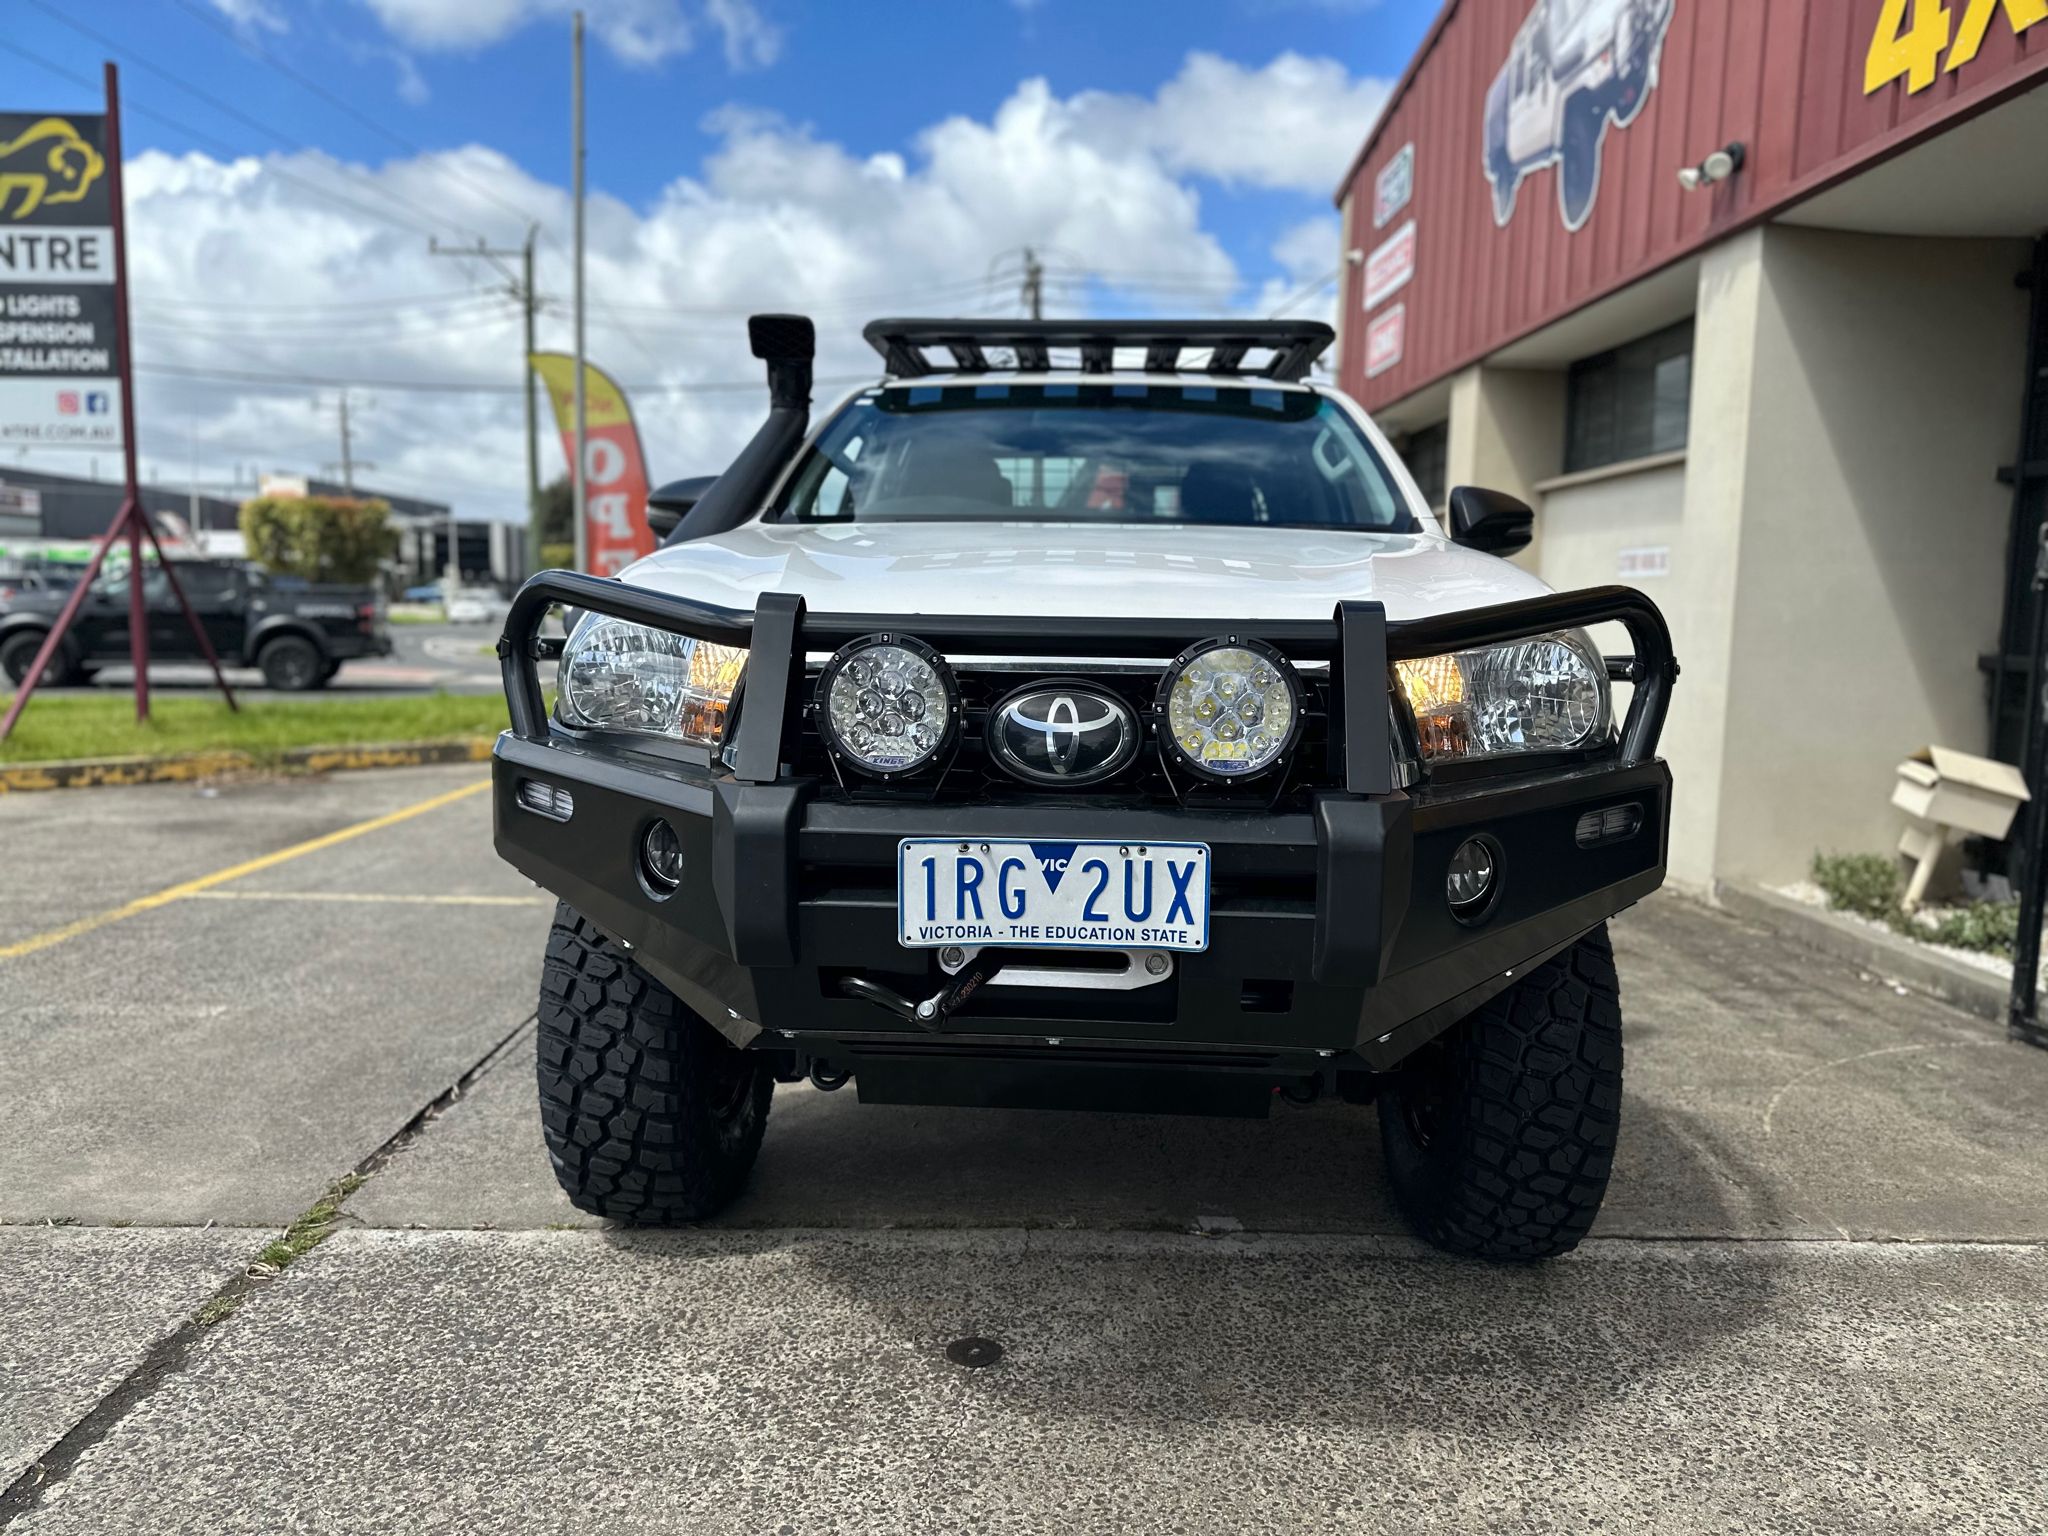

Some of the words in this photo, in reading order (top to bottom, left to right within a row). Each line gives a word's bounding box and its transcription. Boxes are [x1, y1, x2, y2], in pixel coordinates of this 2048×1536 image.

[7, 296, 80, 317] LIGHTS
[0, 349, 109, 371] TALLATION
[872, 757, 905, 765] KINGS
[1038, 857, 1069, 873] VIC
[921, 856, 1026, 921] 1RG
[1081, 858, 1197, 926] 2UX
[919, 925, 993, 940] VICTORIA
[1010, 925, 1040, 939] THE
[1045, 926, 1136, 941] EDUCATION
[1141, 928, 1188, 943] STATE
